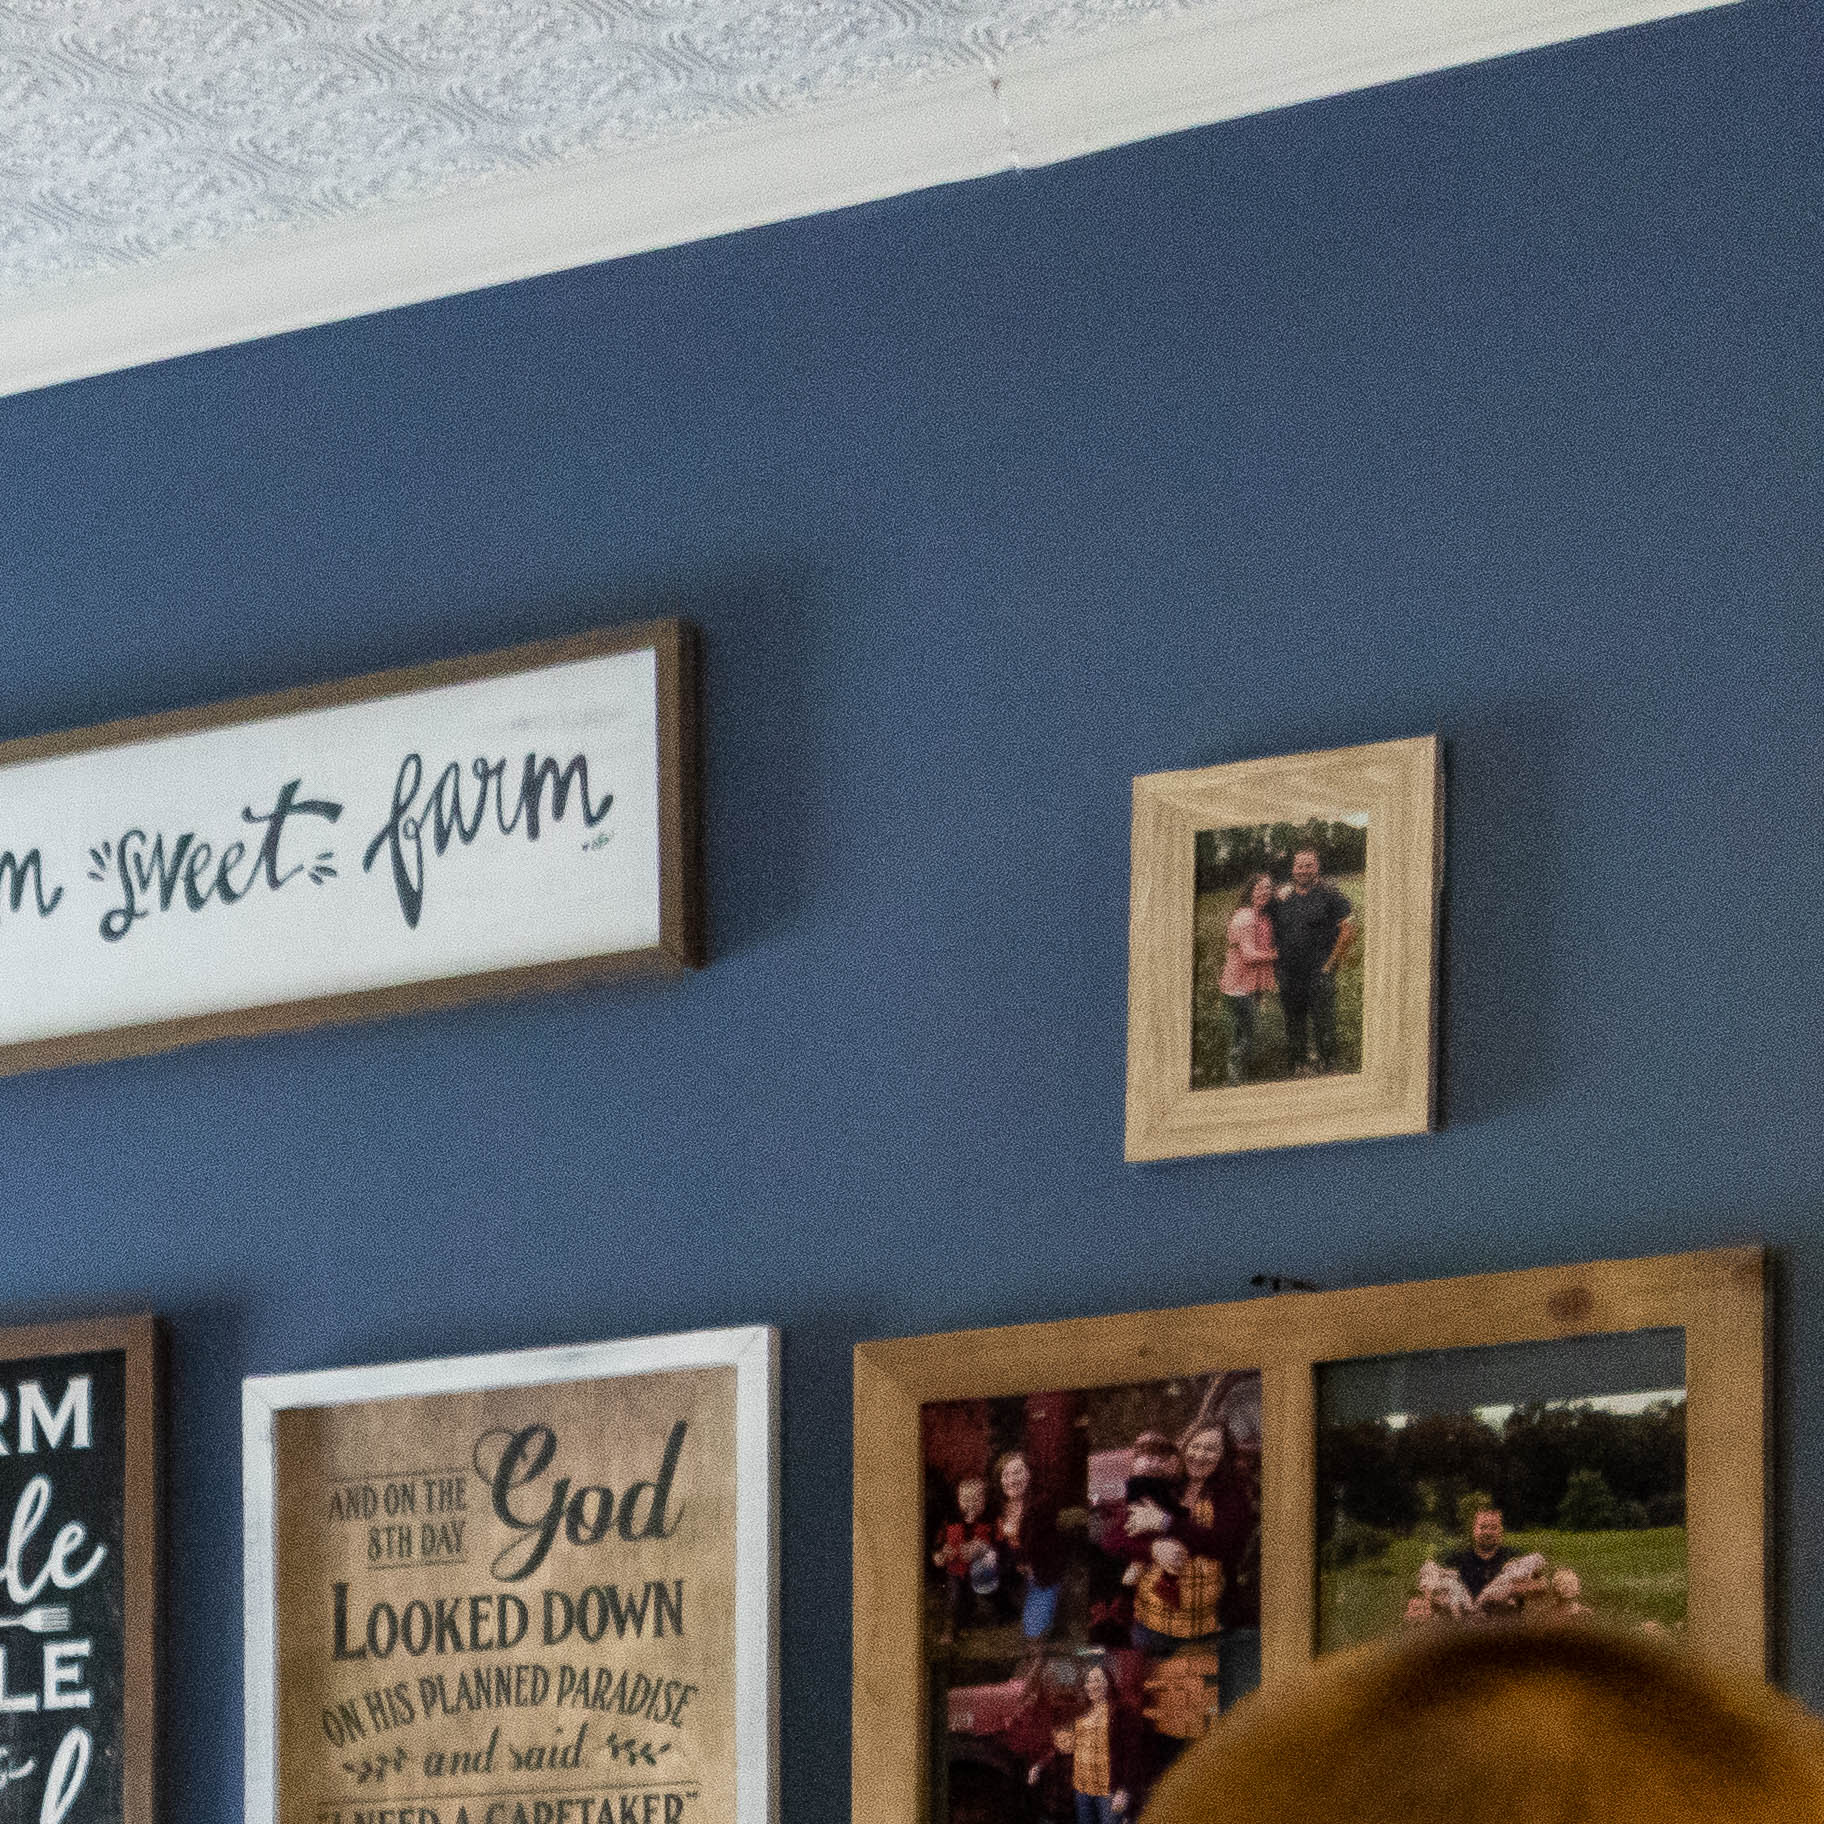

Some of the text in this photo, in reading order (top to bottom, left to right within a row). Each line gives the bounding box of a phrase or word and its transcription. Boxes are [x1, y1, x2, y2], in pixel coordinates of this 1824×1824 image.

[98, 779, 342, 944] sweet
[364, 753, 614, 929] farm
[331, 1476, 467, 1520] AND ON THE
[472, 1420, 688, 1583] God
[367, 1521, 466, 1561] 8TH DAY
[333, 1579, 686, 1661] LOOKED DOWN
[322, 1664, 699, 1748] ON HIS PLANNED PARADISE
[423, 1721, 589, 1777] and said
